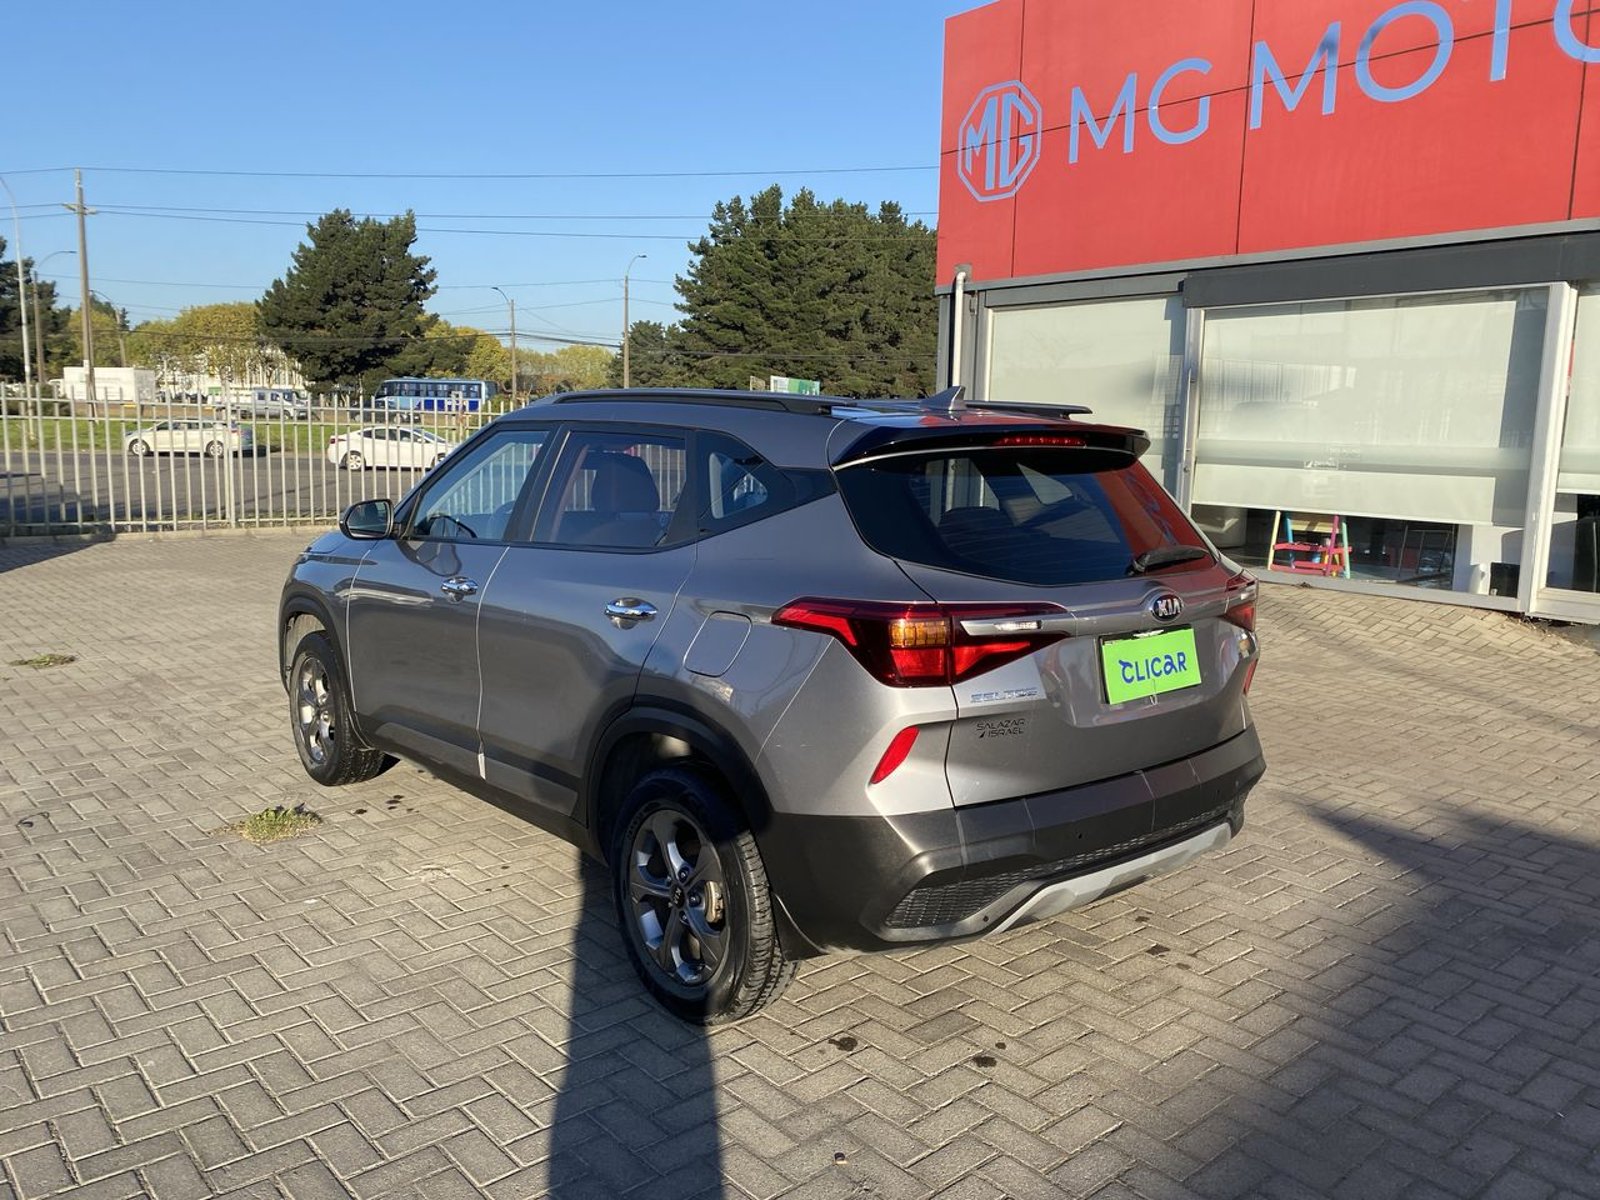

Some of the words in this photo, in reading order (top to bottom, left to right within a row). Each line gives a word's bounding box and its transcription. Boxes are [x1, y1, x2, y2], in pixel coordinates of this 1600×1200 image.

[1069, 58, 1213, 164] MG
[965, 92, 1034, 191] MG
[1157, 598, 1181, 616] KIA
[976, 718, 1026, 731] SALAZAR
[987, 727, 1025, 738] ISRAEL
